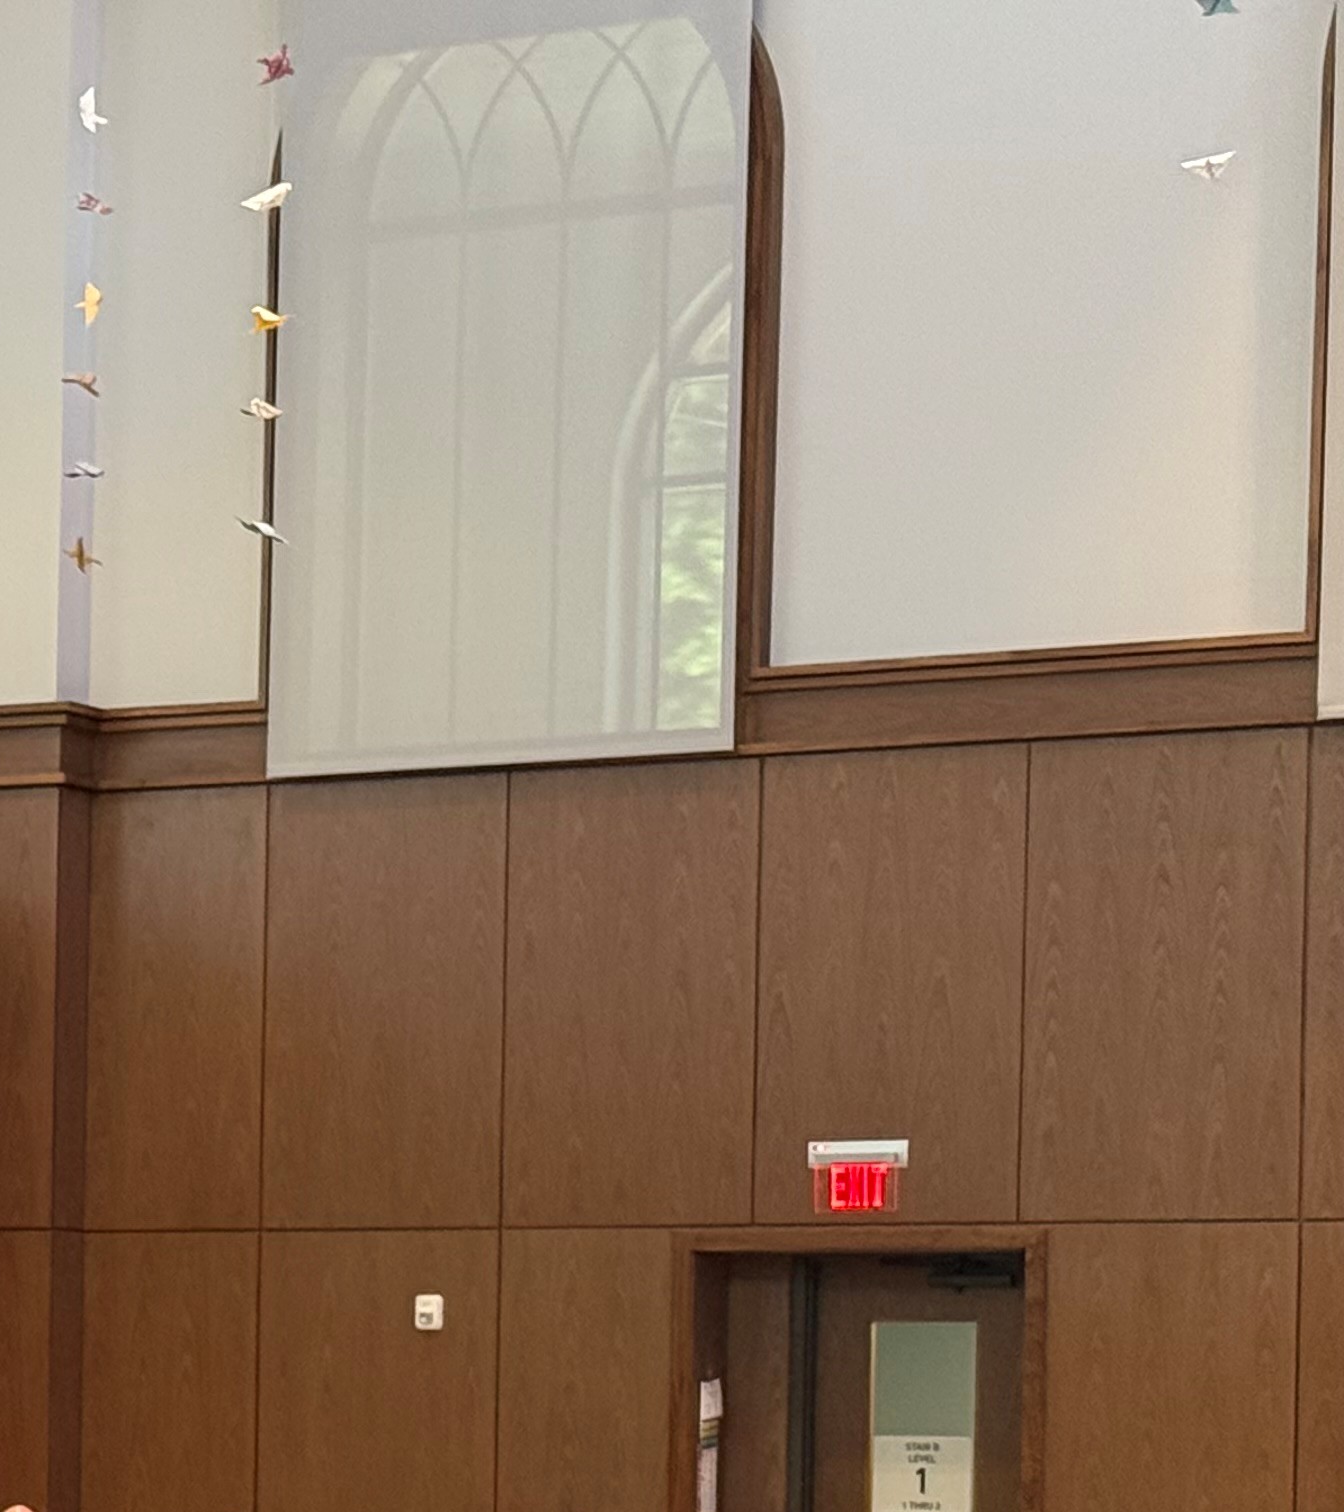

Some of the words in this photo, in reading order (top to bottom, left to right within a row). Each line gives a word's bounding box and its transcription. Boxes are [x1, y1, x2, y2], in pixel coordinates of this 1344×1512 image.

[830, 1163, 888, 1208] EXIT
[907, 1453, 937, 1465] LEVEL
[915, 1466, 927, 1496] 1
